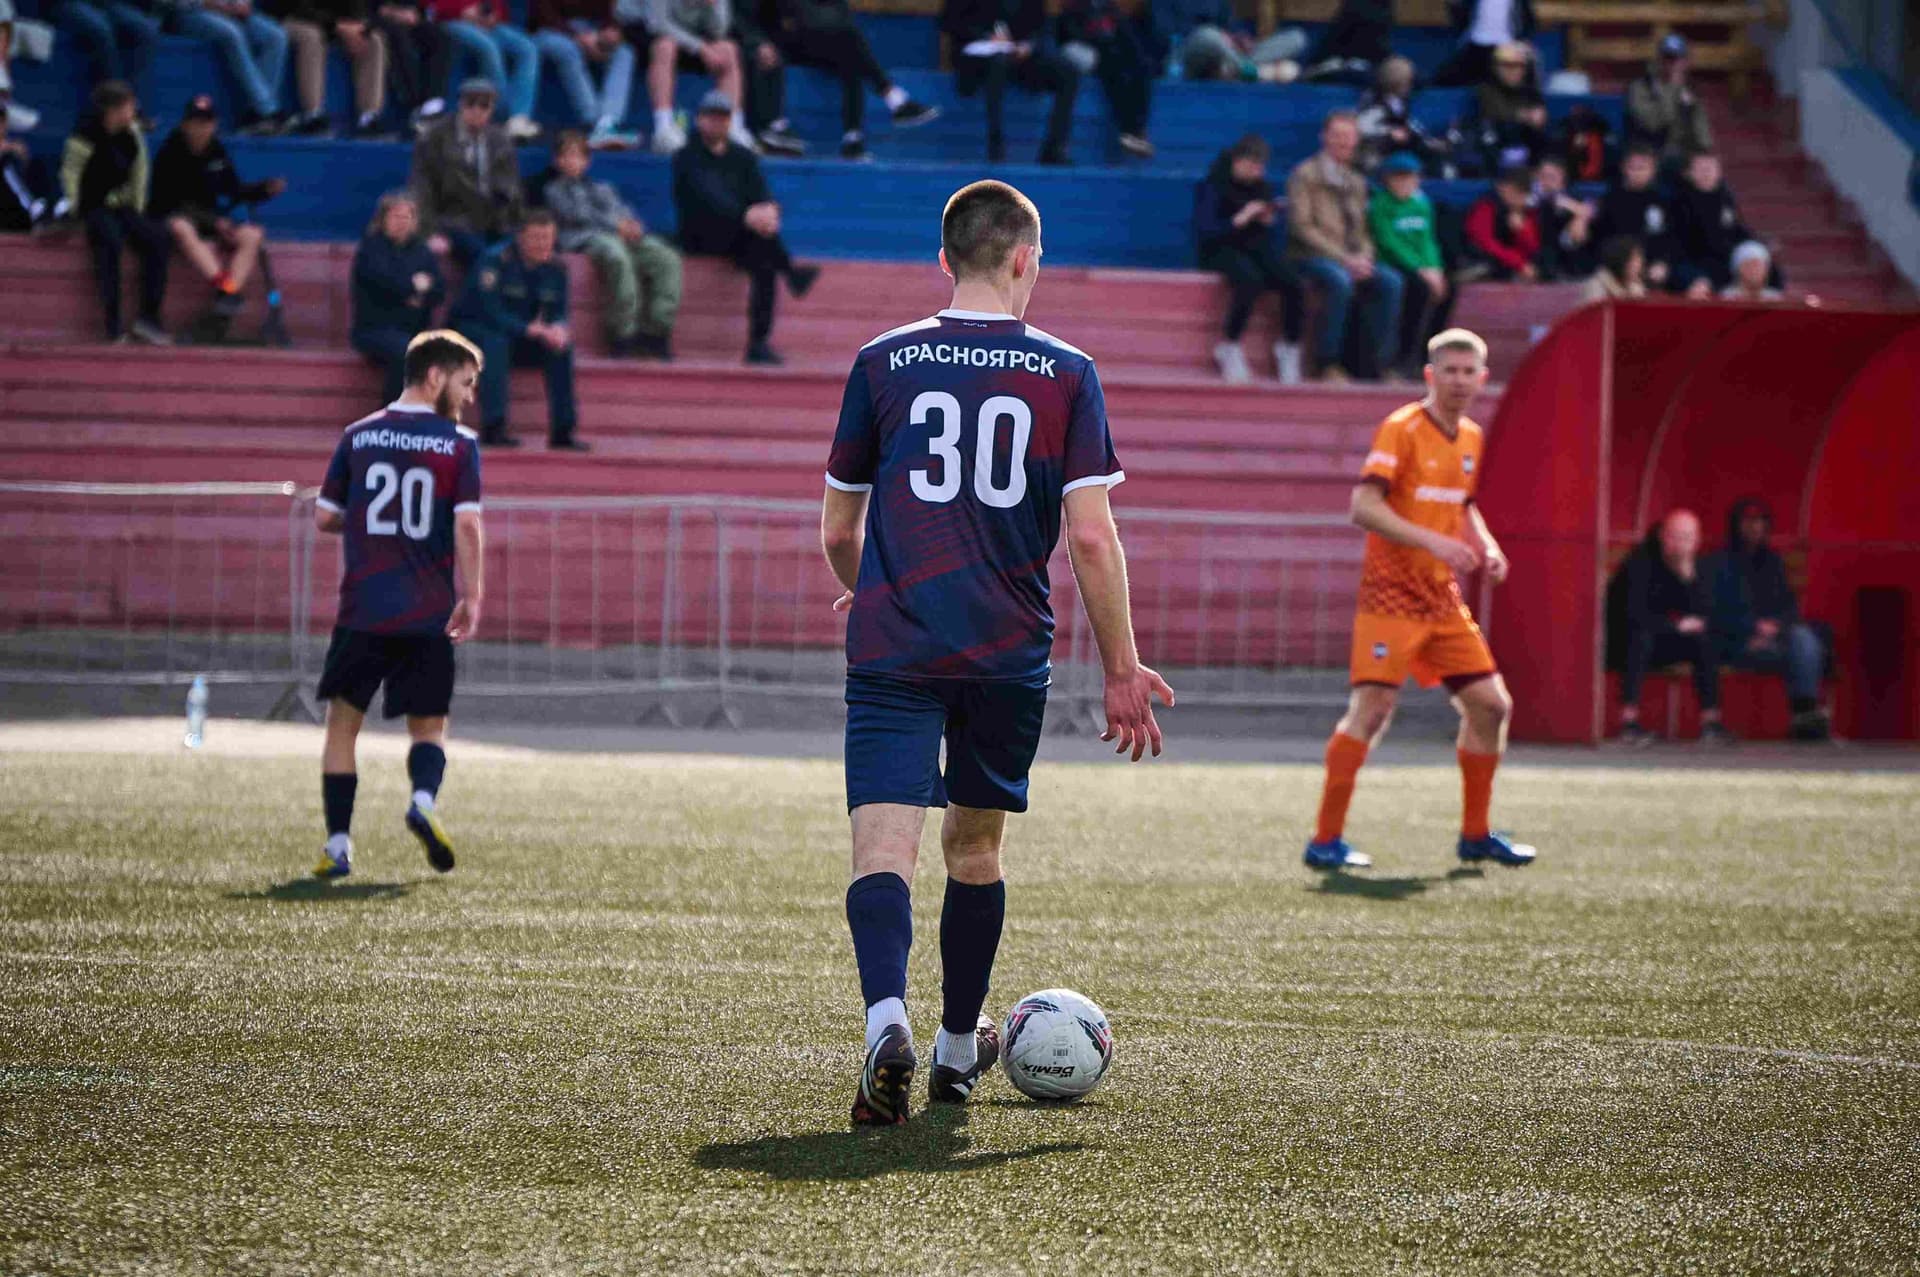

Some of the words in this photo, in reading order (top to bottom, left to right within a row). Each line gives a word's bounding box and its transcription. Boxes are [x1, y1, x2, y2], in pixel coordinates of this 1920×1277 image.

[889, 343, 1056, 377] КРАСНОЯРСК
[352, 429, 455, 455] КРАСНОЯРСК
[909, 391, 1031, 508] 30
[365, 462, 434, 540] 20
[1021, 1064, 1075, 1077] DEMIX
